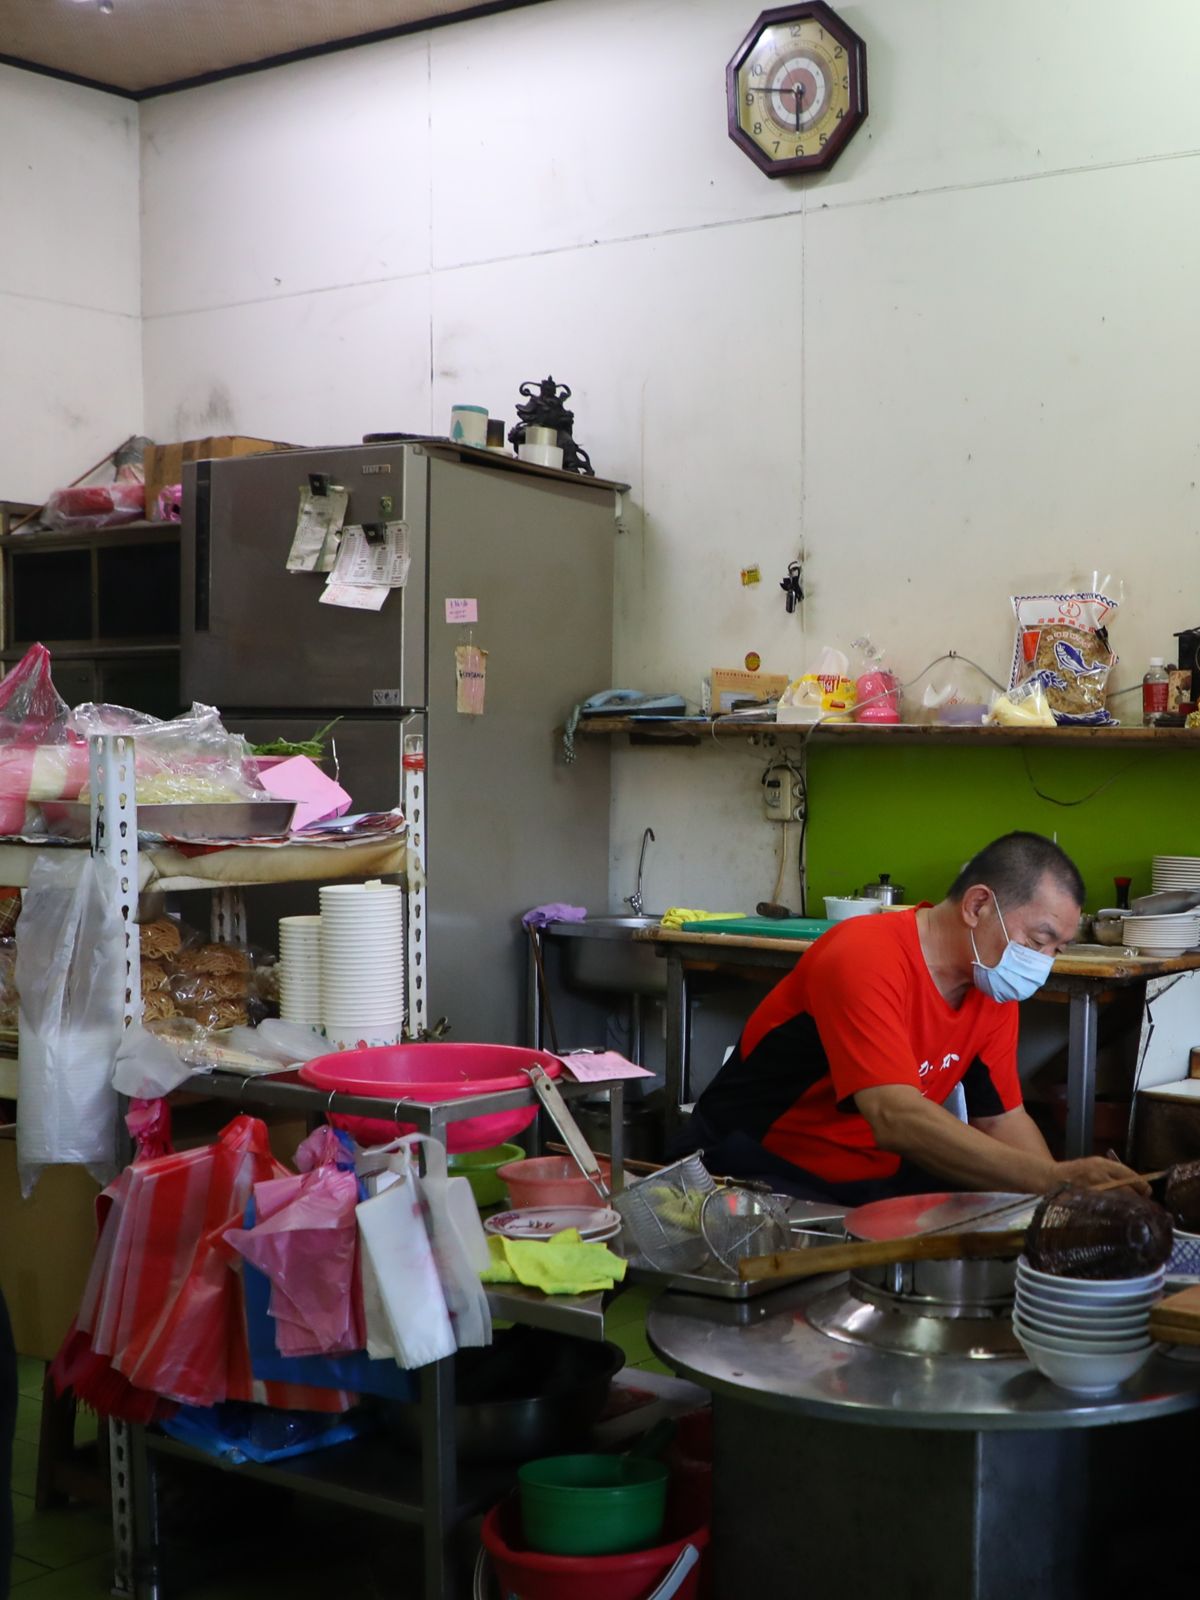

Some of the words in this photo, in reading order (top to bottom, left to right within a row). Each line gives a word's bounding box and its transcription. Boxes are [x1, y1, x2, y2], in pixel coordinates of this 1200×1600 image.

[789, 24, 801, 38] 12
[834, 46, 843, 59] 2
[750, 63, 763, 77] 10
[745, 93, 755, 106] 9
[835, 107, 845, 121] 4
[753, 121, 763, 136] 8
[819, 133, 829, 147] 5
[772, 141, 781, 154] 7
[795, 144, 805, 158] 6
